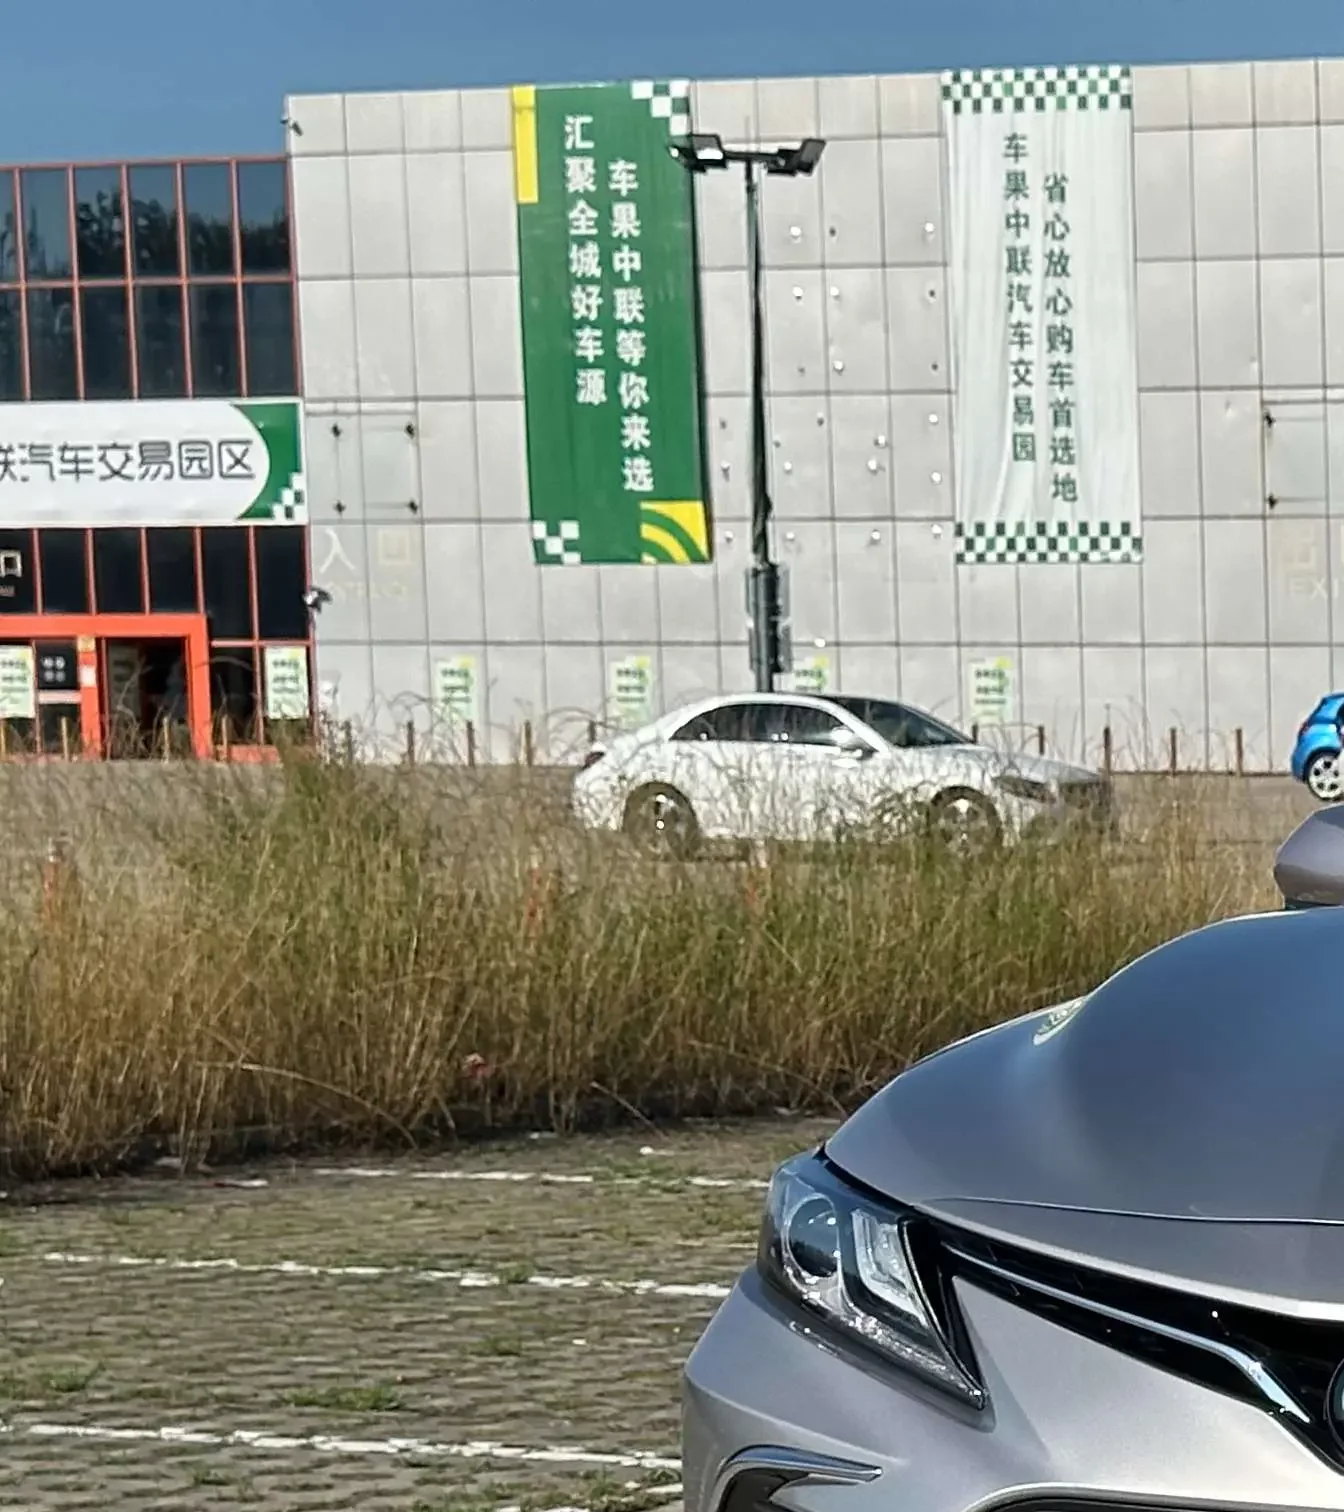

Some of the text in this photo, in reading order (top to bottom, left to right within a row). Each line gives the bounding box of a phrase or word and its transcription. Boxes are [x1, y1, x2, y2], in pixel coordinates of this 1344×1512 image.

[564, 114, 608, 407] 汇聚全城好车源
[607, 158, 654, 493] 车果中联等你来选
[1001, 132, 1037, 463] 车果中联汽车交易园
[1042, 172, 1079, 502] 省心放心购车首选地
